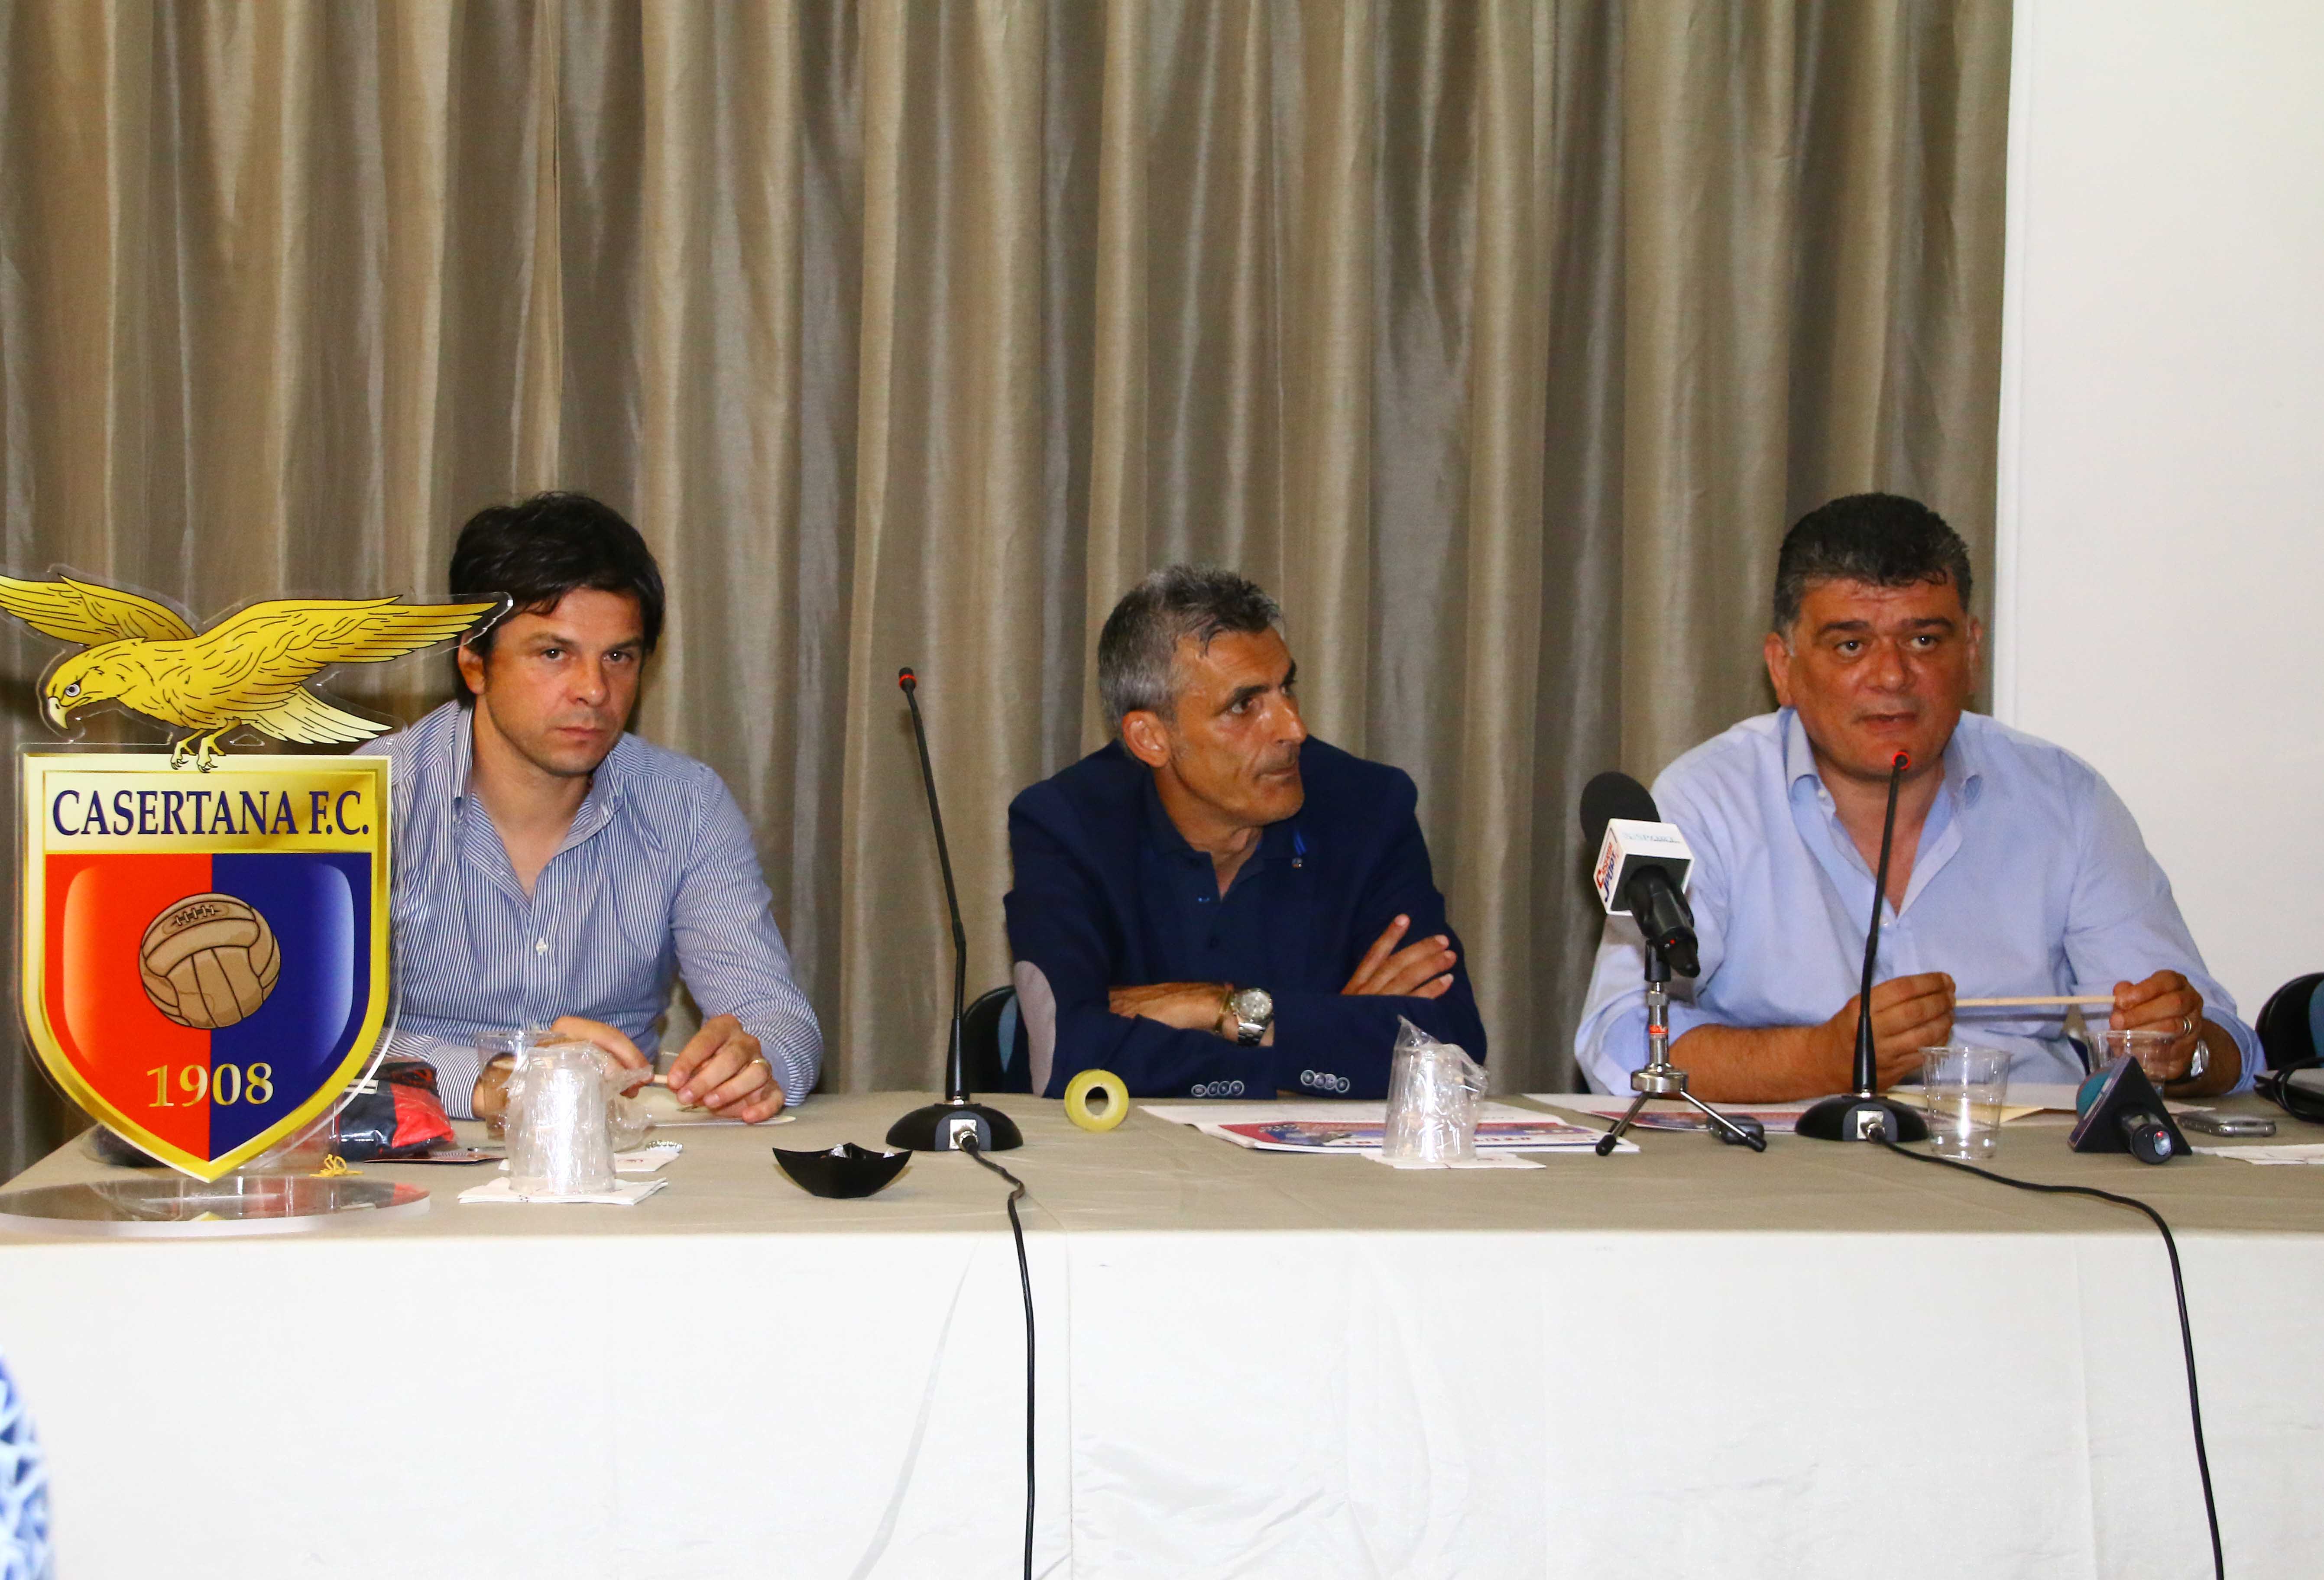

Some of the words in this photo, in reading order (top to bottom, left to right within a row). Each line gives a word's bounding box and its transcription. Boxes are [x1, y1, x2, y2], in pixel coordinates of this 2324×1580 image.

[52, 790, 298, 836] CASERTANA
[308, 790, 369, 835] F.C.
[146, 1062, 274, 1107] 1908
